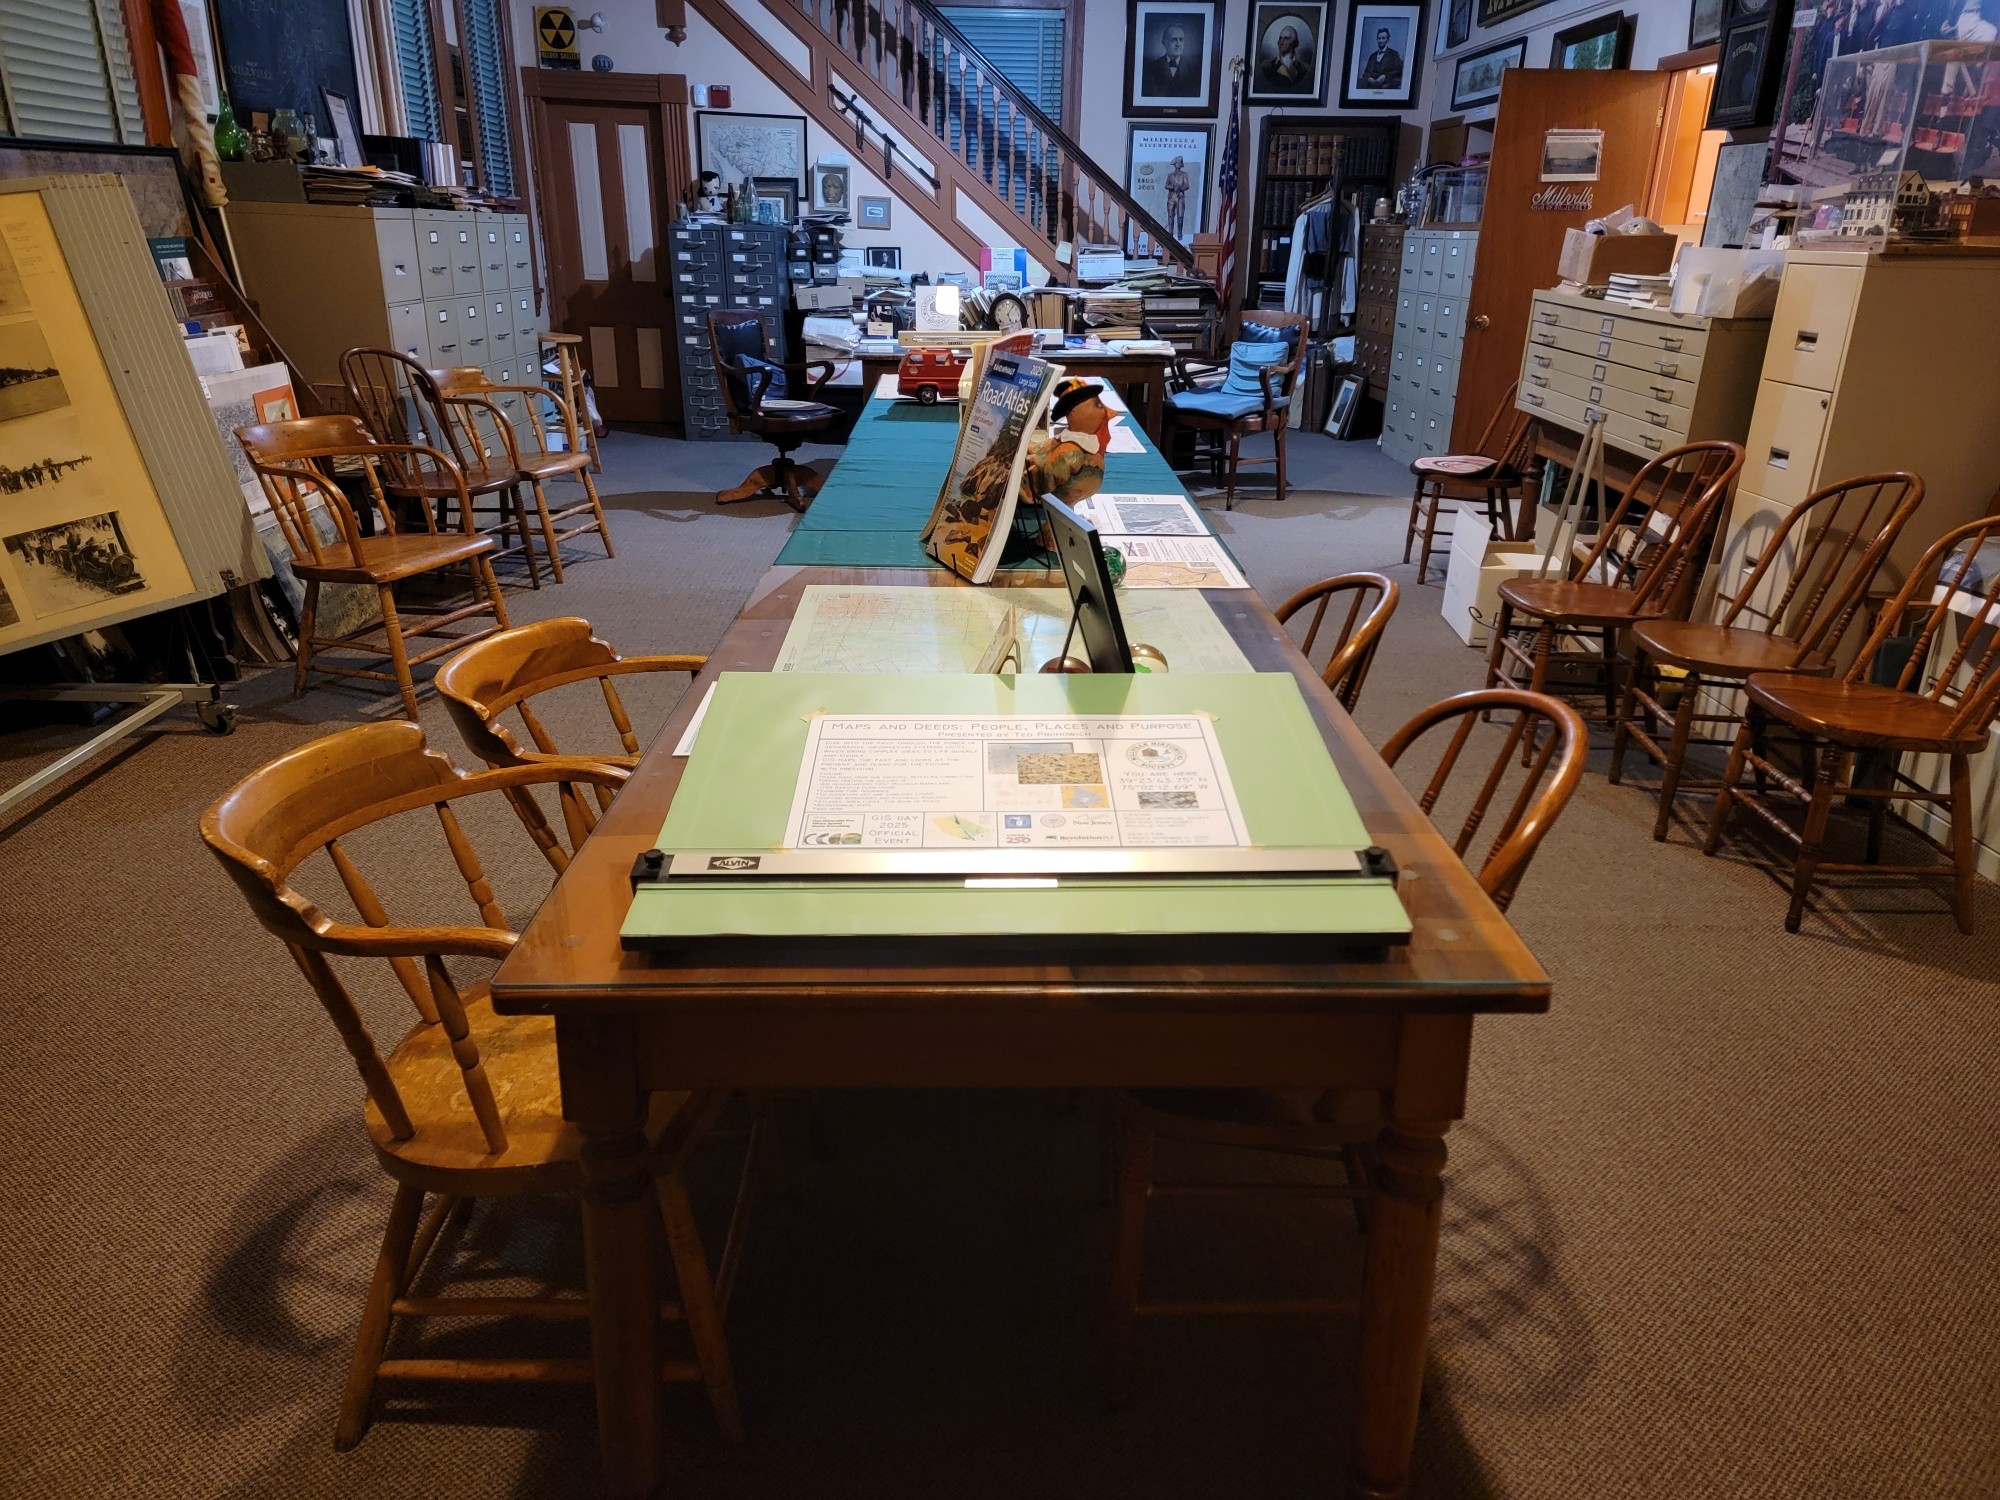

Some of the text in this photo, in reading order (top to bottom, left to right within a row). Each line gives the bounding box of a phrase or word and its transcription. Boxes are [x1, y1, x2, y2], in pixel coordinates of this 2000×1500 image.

[1532, 184, 1594, 205] Millville
[1030, 364, 1043, 376] 2025
[1018, 374, 1038, 389] Large Scale
[981, 381, 1031, 415] Road Atlas
[831, 721, 1192, 732] MAPS AND DEEDS: PEOPLE, PLACES AND PURPOSE
[868, 829, 917, 837] OFFICIAL
[1006, 836, 1032, 844] 250
